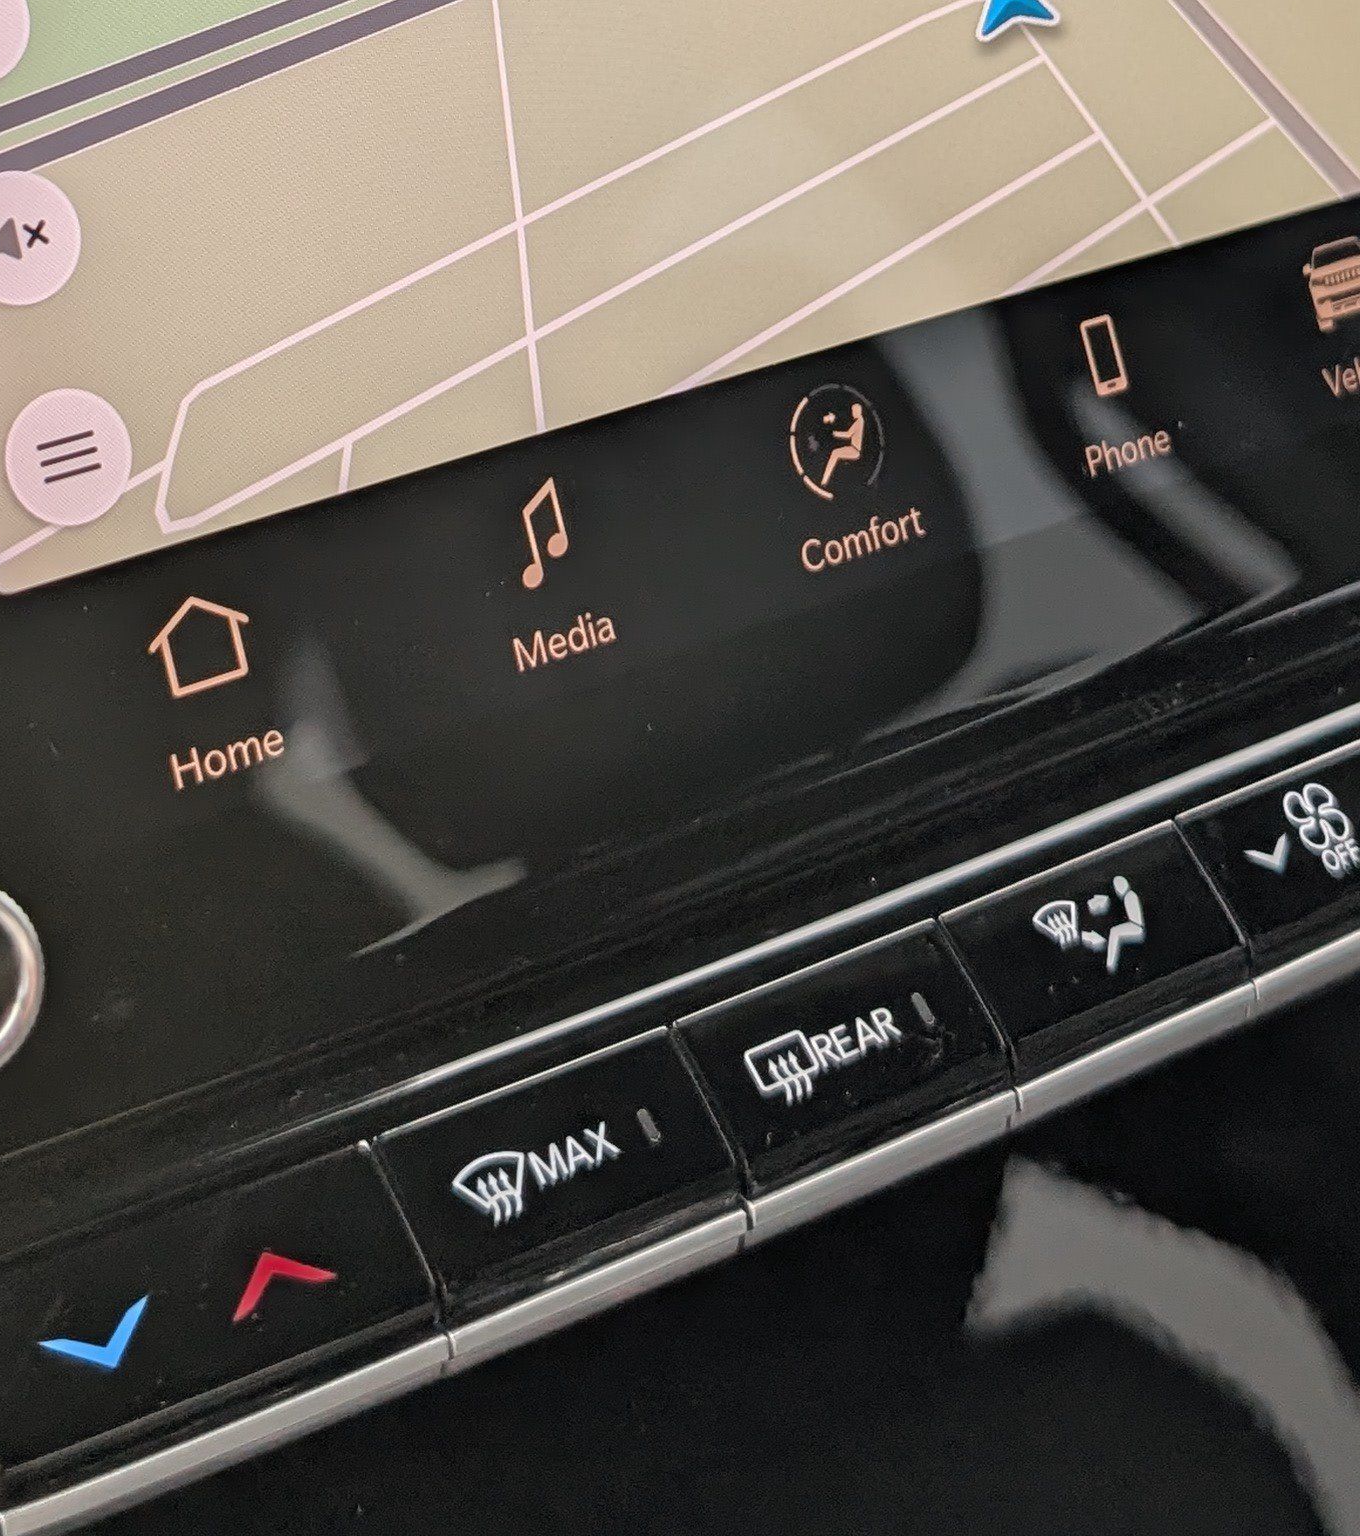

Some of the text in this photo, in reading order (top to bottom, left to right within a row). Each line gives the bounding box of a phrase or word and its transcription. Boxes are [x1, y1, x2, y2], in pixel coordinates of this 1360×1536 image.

[1085, 427, 1172, 478] Phone
[801, 507, 926, 572] Comfort
[512, 612, 617, 673] Media
[169, 729, 286, 791] Home
[810, 1007, 902, 1074] REAR
[528, 1121, 621, 1191] MAX
